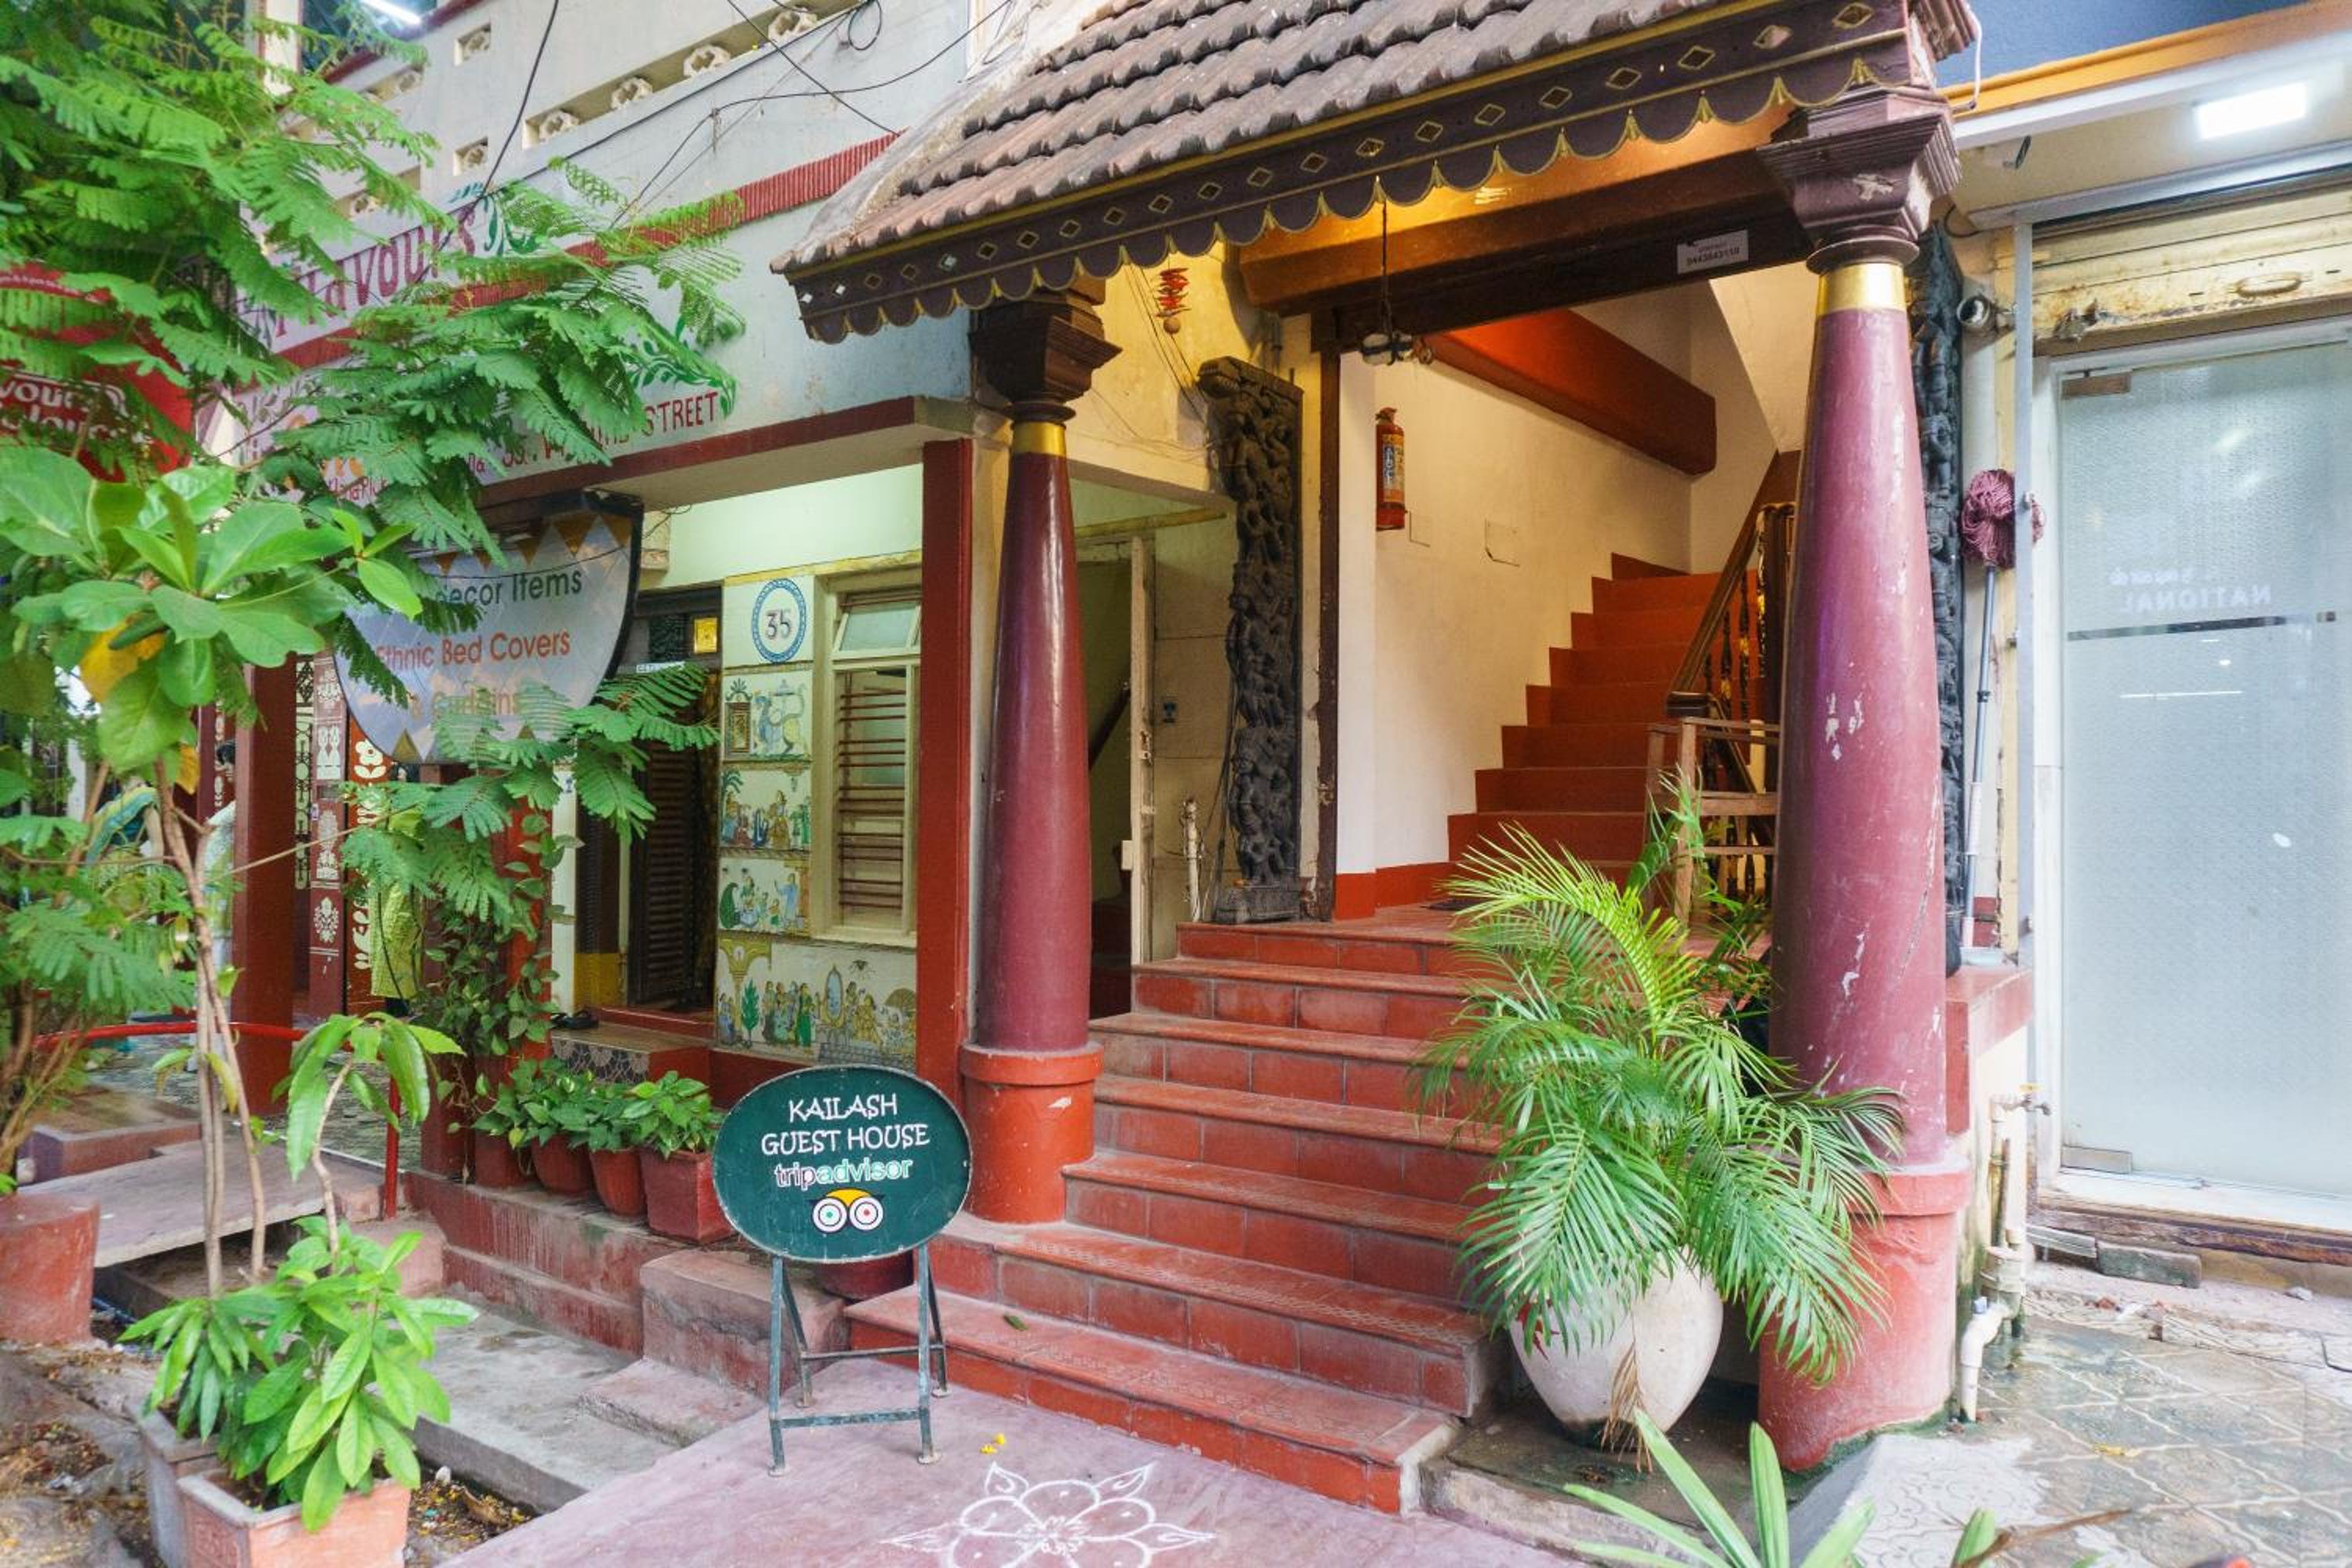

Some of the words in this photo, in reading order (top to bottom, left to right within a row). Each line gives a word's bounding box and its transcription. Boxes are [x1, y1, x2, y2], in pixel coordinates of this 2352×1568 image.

[641, 391, 718, 436] STREET
[512, 572, 583, 602] Items
[764, 608, 792, 641] 35
[442, 636, 483, 665] Bed
[489, 631, 570, 660] Covers
[789, 1094, 897, 1123] KAILASH
[761, 1130, 842, 1156] GUEST
[848, 1124, 931, 1149] HOUSE
[775, 1157, 913, 1191] tripadvisor
